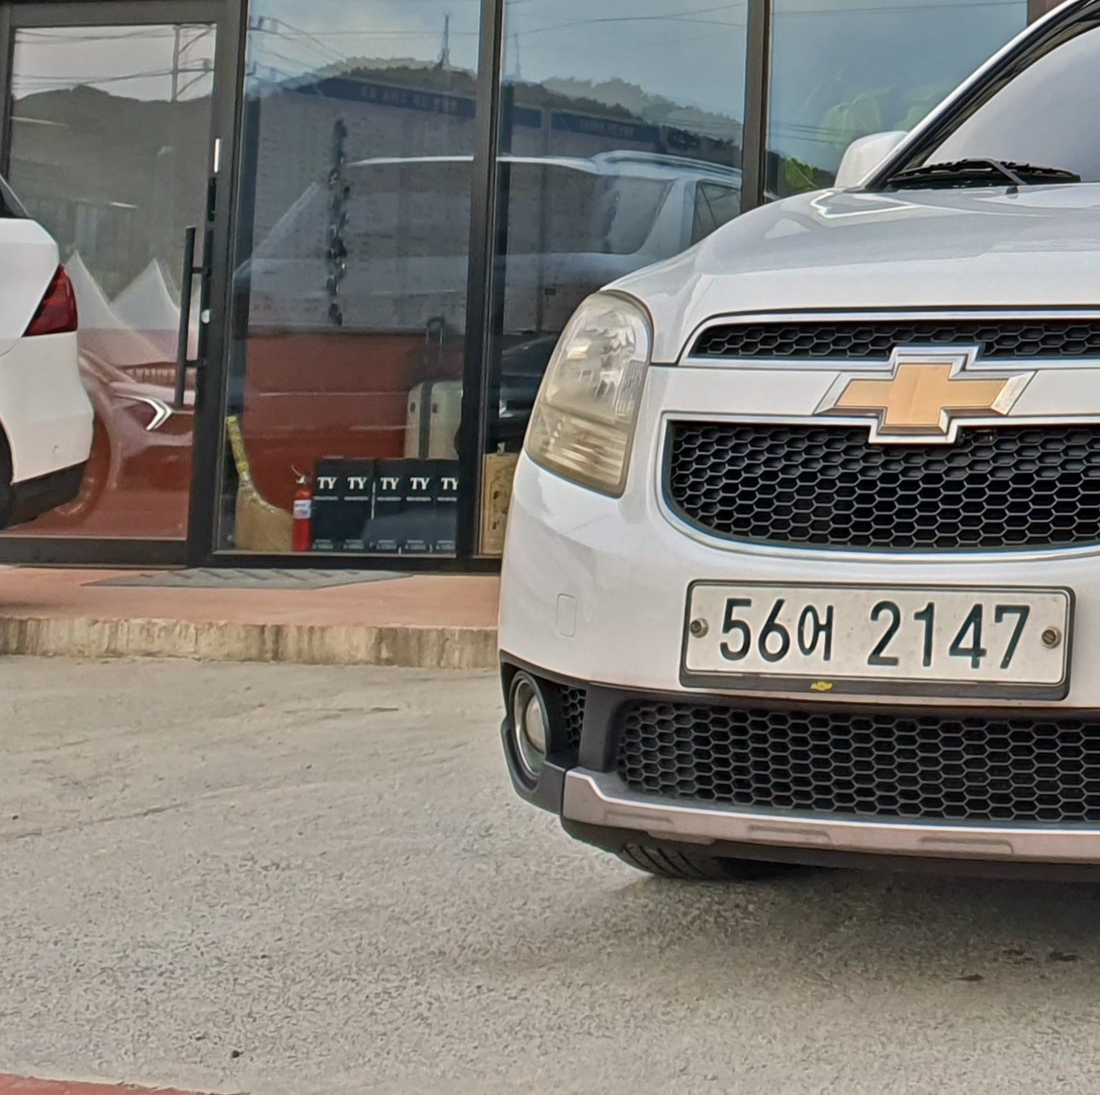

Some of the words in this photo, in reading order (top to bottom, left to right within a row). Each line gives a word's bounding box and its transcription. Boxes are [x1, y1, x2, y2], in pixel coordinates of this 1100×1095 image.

[317, 476, 338, 490] TY
[347, 476, 367, 490] TY
[380, 476, 399, 490] TY
[409, 476, 430, 490] TY
[719, 598, 834, 663] 56어
[867, 600, 1031, 669] 2147
